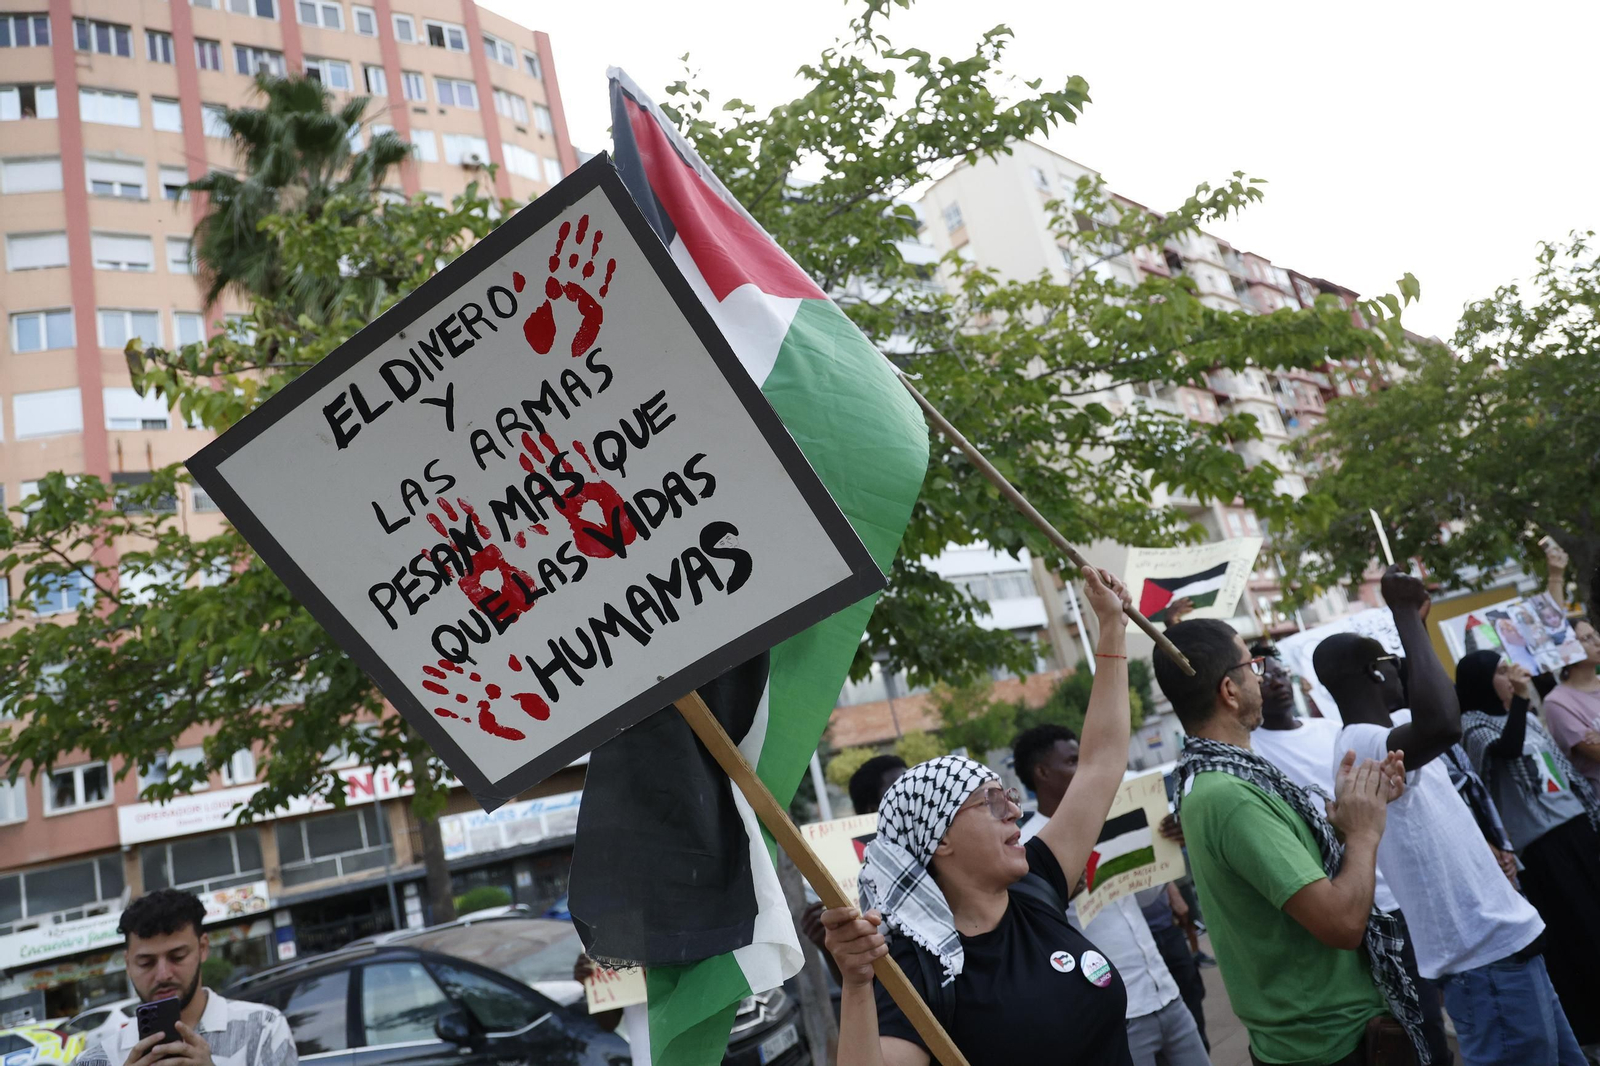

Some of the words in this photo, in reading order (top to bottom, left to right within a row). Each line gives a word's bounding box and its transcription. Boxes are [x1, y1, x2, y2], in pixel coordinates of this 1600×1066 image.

[372, 459, 456, 534] LAS
[470, 347, 613, 470] ARMAS
[420, 382, 454, 432] Y
[368, 514, 484, 630] PESAN
[489, 451, 584, 542] MAS
[593, 390, 676, 478] QUE
[431, 590, 518, 665] QUE
[511, 541, 588, 603] LAS
[583, 453, 716, 559] VIDAS
[525, 520, 752, 702] HUMANAS
